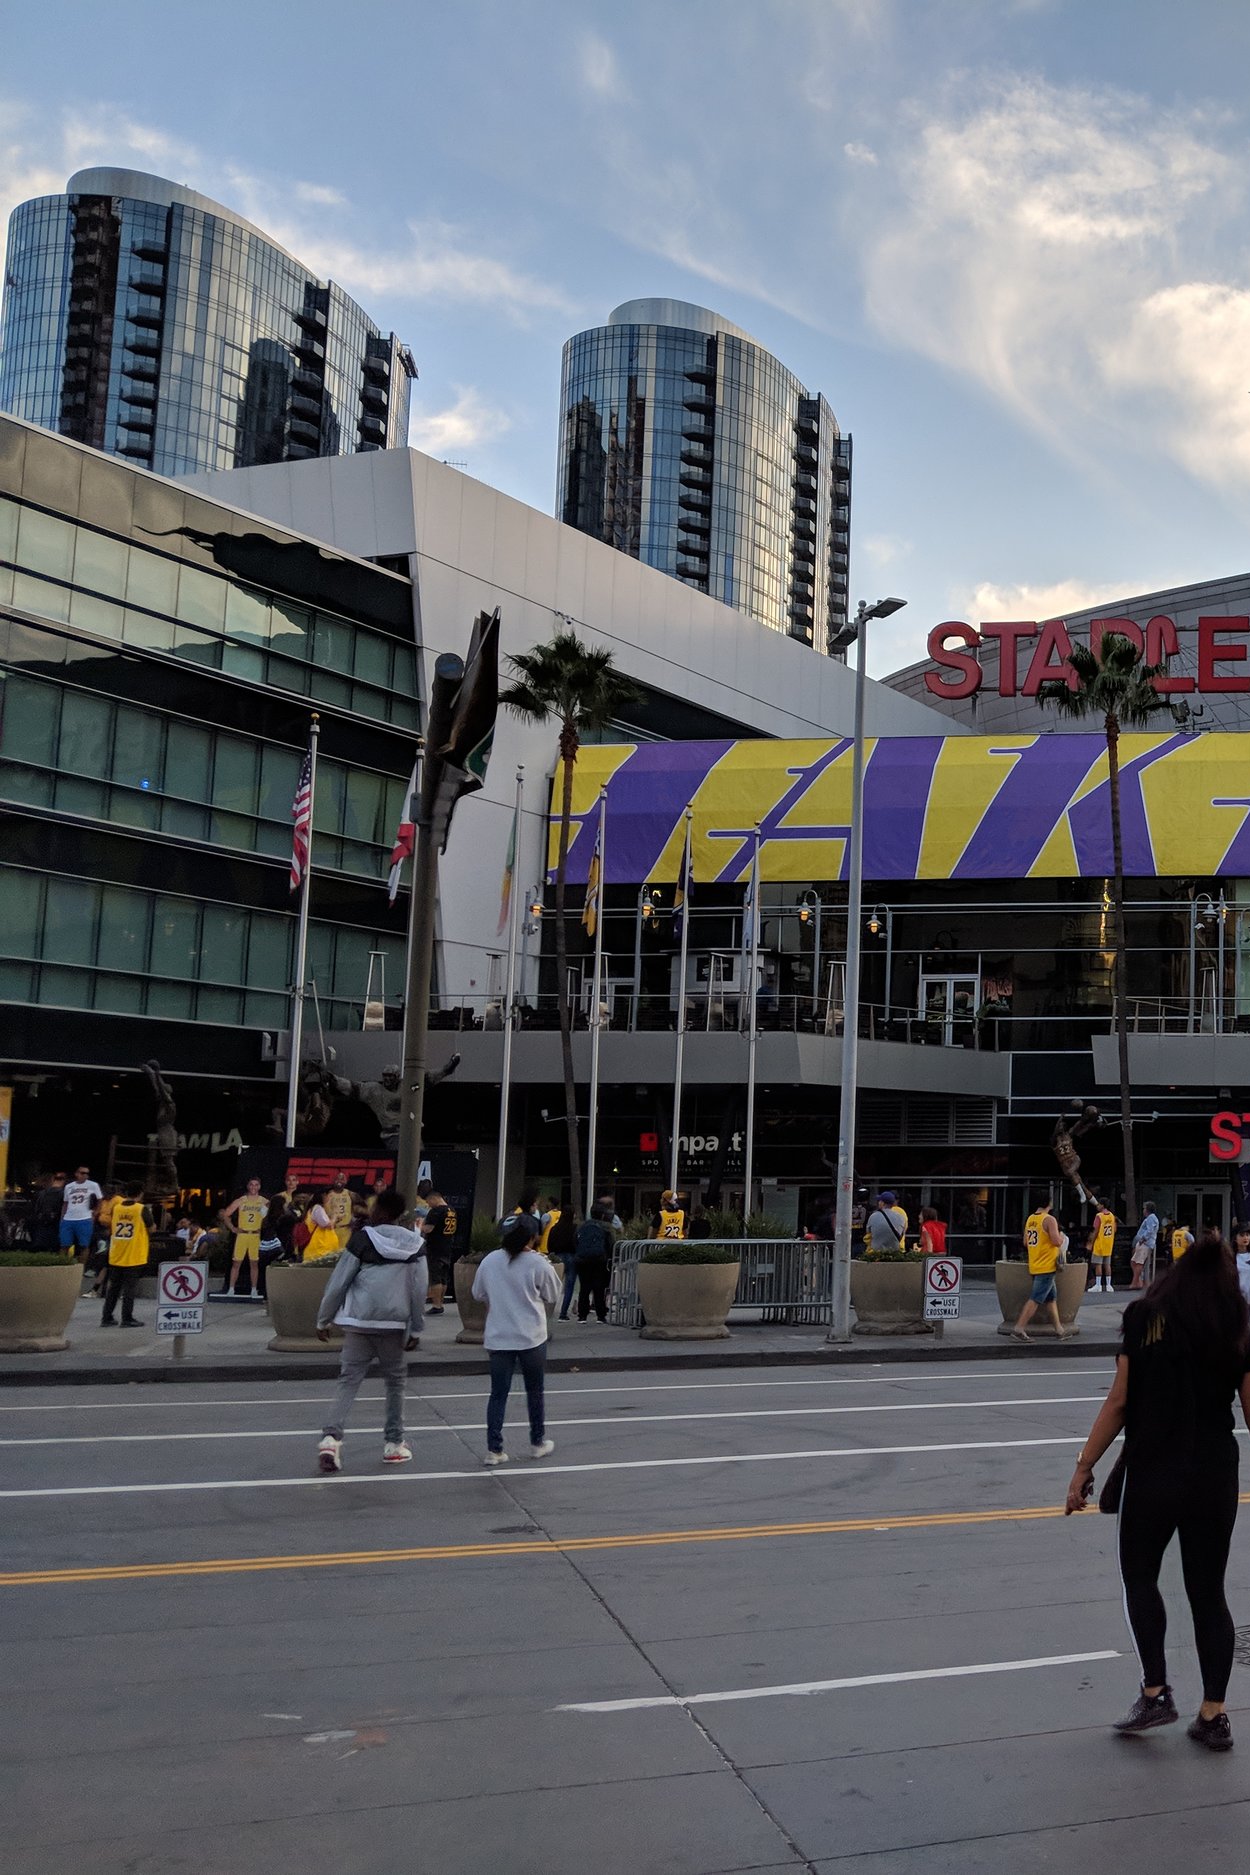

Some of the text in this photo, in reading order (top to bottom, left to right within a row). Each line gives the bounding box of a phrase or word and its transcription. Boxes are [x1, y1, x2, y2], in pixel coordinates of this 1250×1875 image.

[146, 1133, 210, 1150] TAM
[285, 1156, 397, 1187] ESPN
[115, 1222, 134, 1238] 23
[443, 1217, 458, 1236] 23
[1103, 1225, 1113, 1236] 23
[1026, 1229, 1039, 1246] 23
[943, 1298, 957, 1307] USE
[181, 1310, 199, 1320] USE
[926, 1308, 958, 1316] CROSSWALK
[158, 1321, 202, 1331] CROSSWALK
